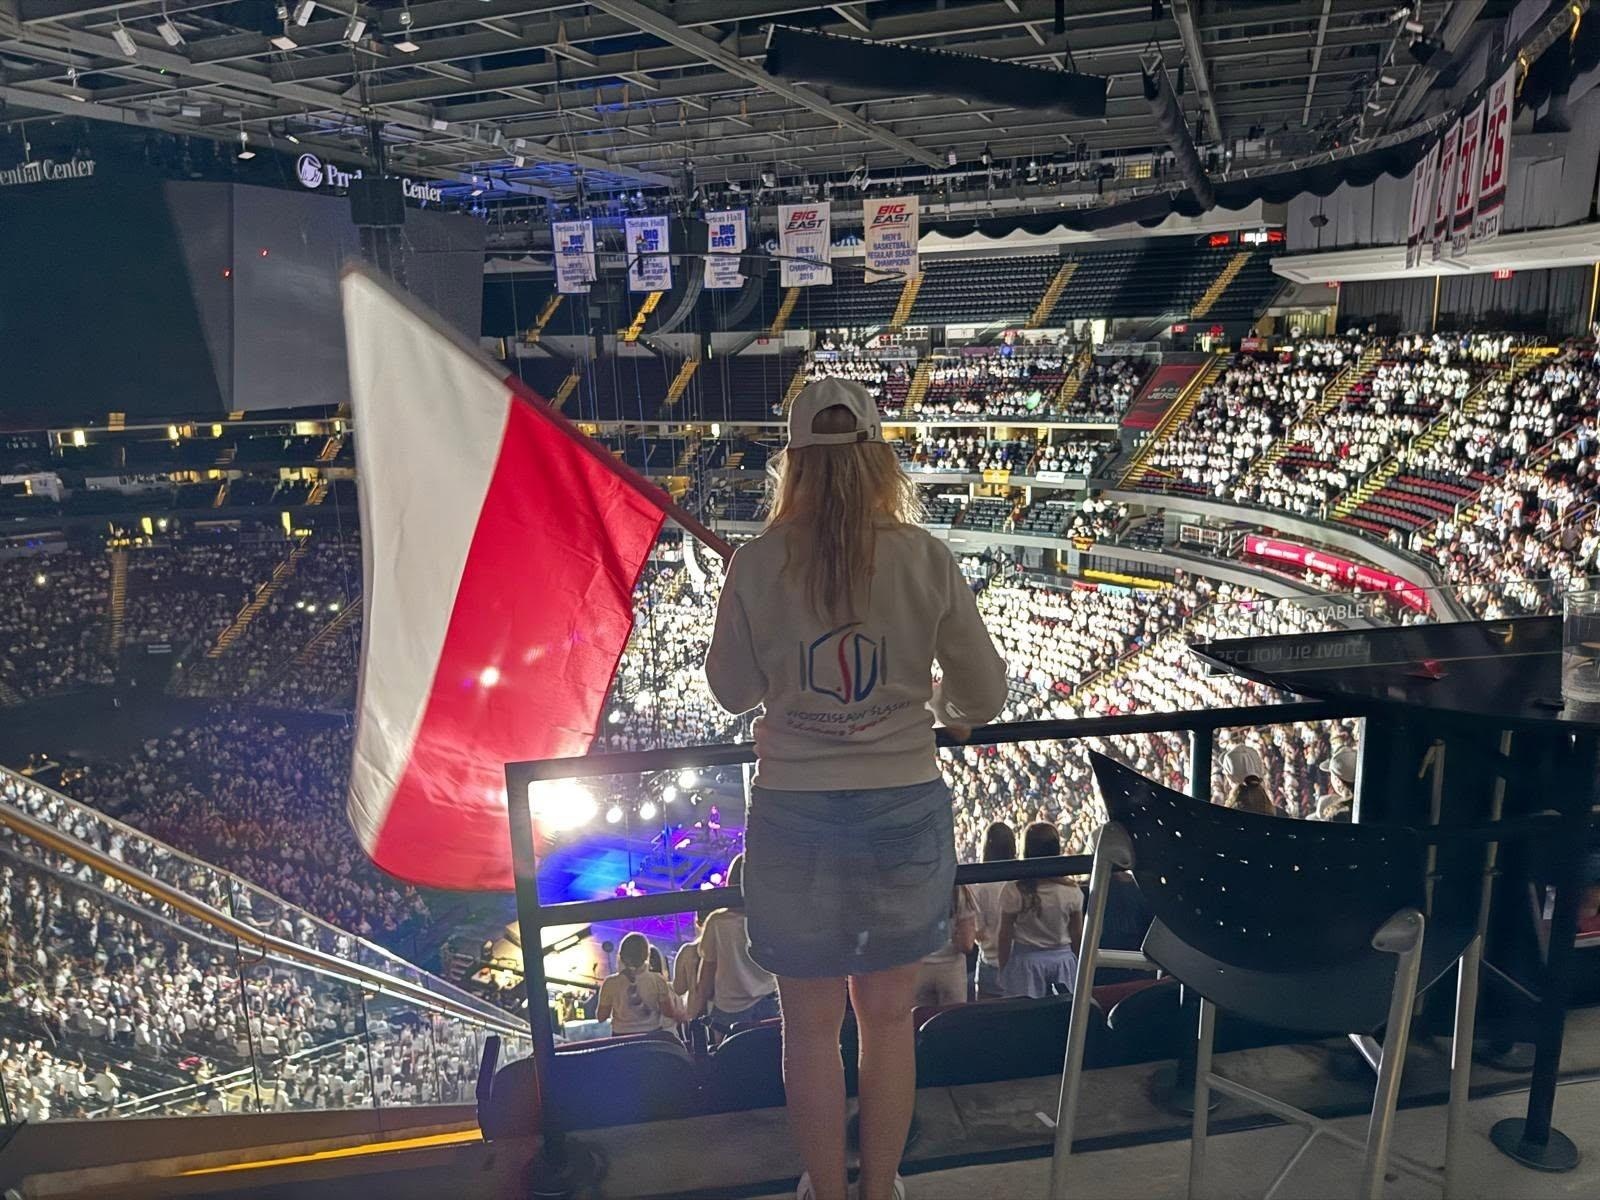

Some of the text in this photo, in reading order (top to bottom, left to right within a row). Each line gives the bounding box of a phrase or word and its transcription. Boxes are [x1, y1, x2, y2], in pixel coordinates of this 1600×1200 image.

[1482, 104, 1508, 192] 26
[43, 157, 96, 180] Center
[1457, 134, 1478, 211] 30
[402, 178, 443, 202] Center
[877, 203, 907, 215] BIG
[792, 210, 818, 221] BIG
[872, 212, 913, 224] EAST
[720, 223, 736, 235] BIG
[785, 219, 825, 230] EAST
[643, 229, 659, 240] BIG
[882, 233, 902, 241] MEN'S
[712, 235, 736, 247] EAST
[873, 241, 910, 250] BASKETBALL
[867, 249, 917, 259] REGULAR SEASON
[874, 258, 910, 267] CHAMPIONS
[1318, 604, 1365, 621] TABLE
